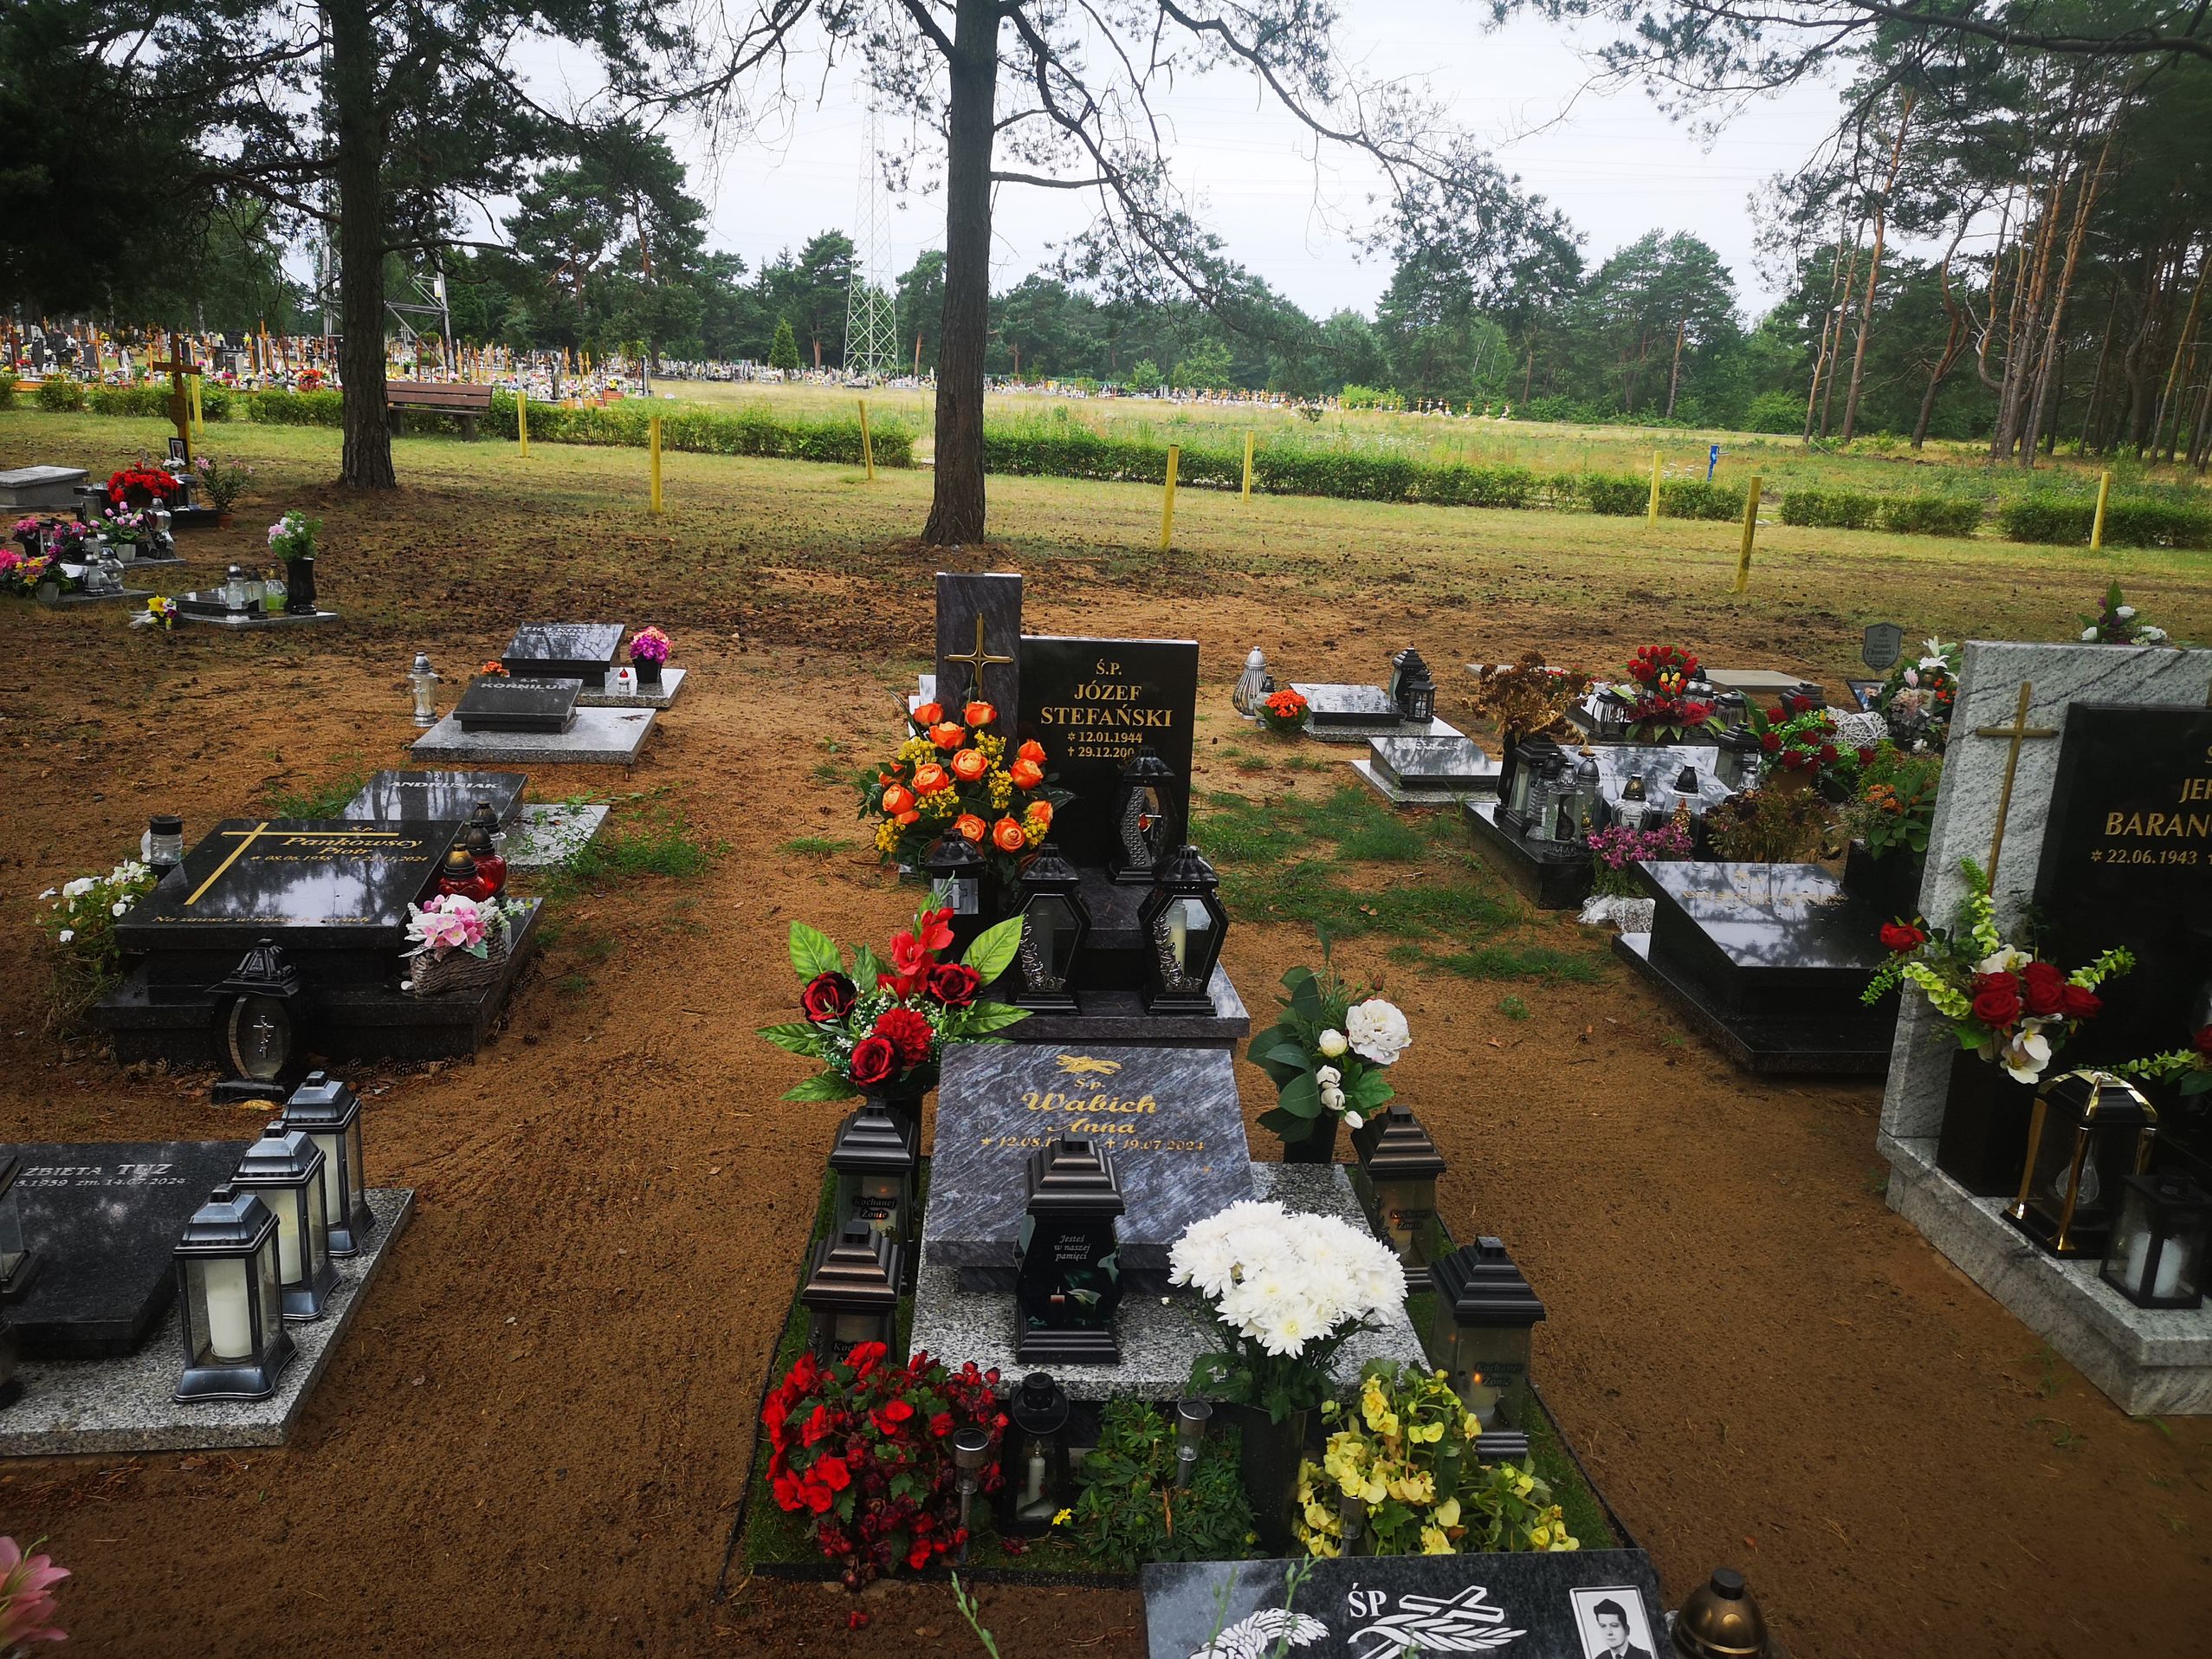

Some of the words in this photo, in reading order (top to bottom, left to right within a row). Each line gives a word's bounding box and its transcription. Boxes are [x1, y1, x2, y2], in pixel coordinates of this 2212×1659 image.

[1096, 658, 1122, 676] Ś.P.
[1074, 680, 1142, 700] JÓZEF
[1040, 704, 1173, 728] STEFAŃSKI
[1079, 731, 1143, 743] 12.01.1944
[1077, 747, 1135, 758] 29.12.200
[2105, 812, 2212, 837] BARAN
[281, 837, 423, 849] Pankowscy
[2106, 849, 2197, 865] 22.06.1943
[1021, 1092, 1159, 1114] Wabich
[1047, 1118, 1136, 1134] Anna
[1059, 1235, 1085, 1243] Jesteś
[1064, 1243, 1090, 1254] naszej
[1054, 1252, 1088, 1262] pamięci
[1348, 1582, 1387, 1617] ŚP
